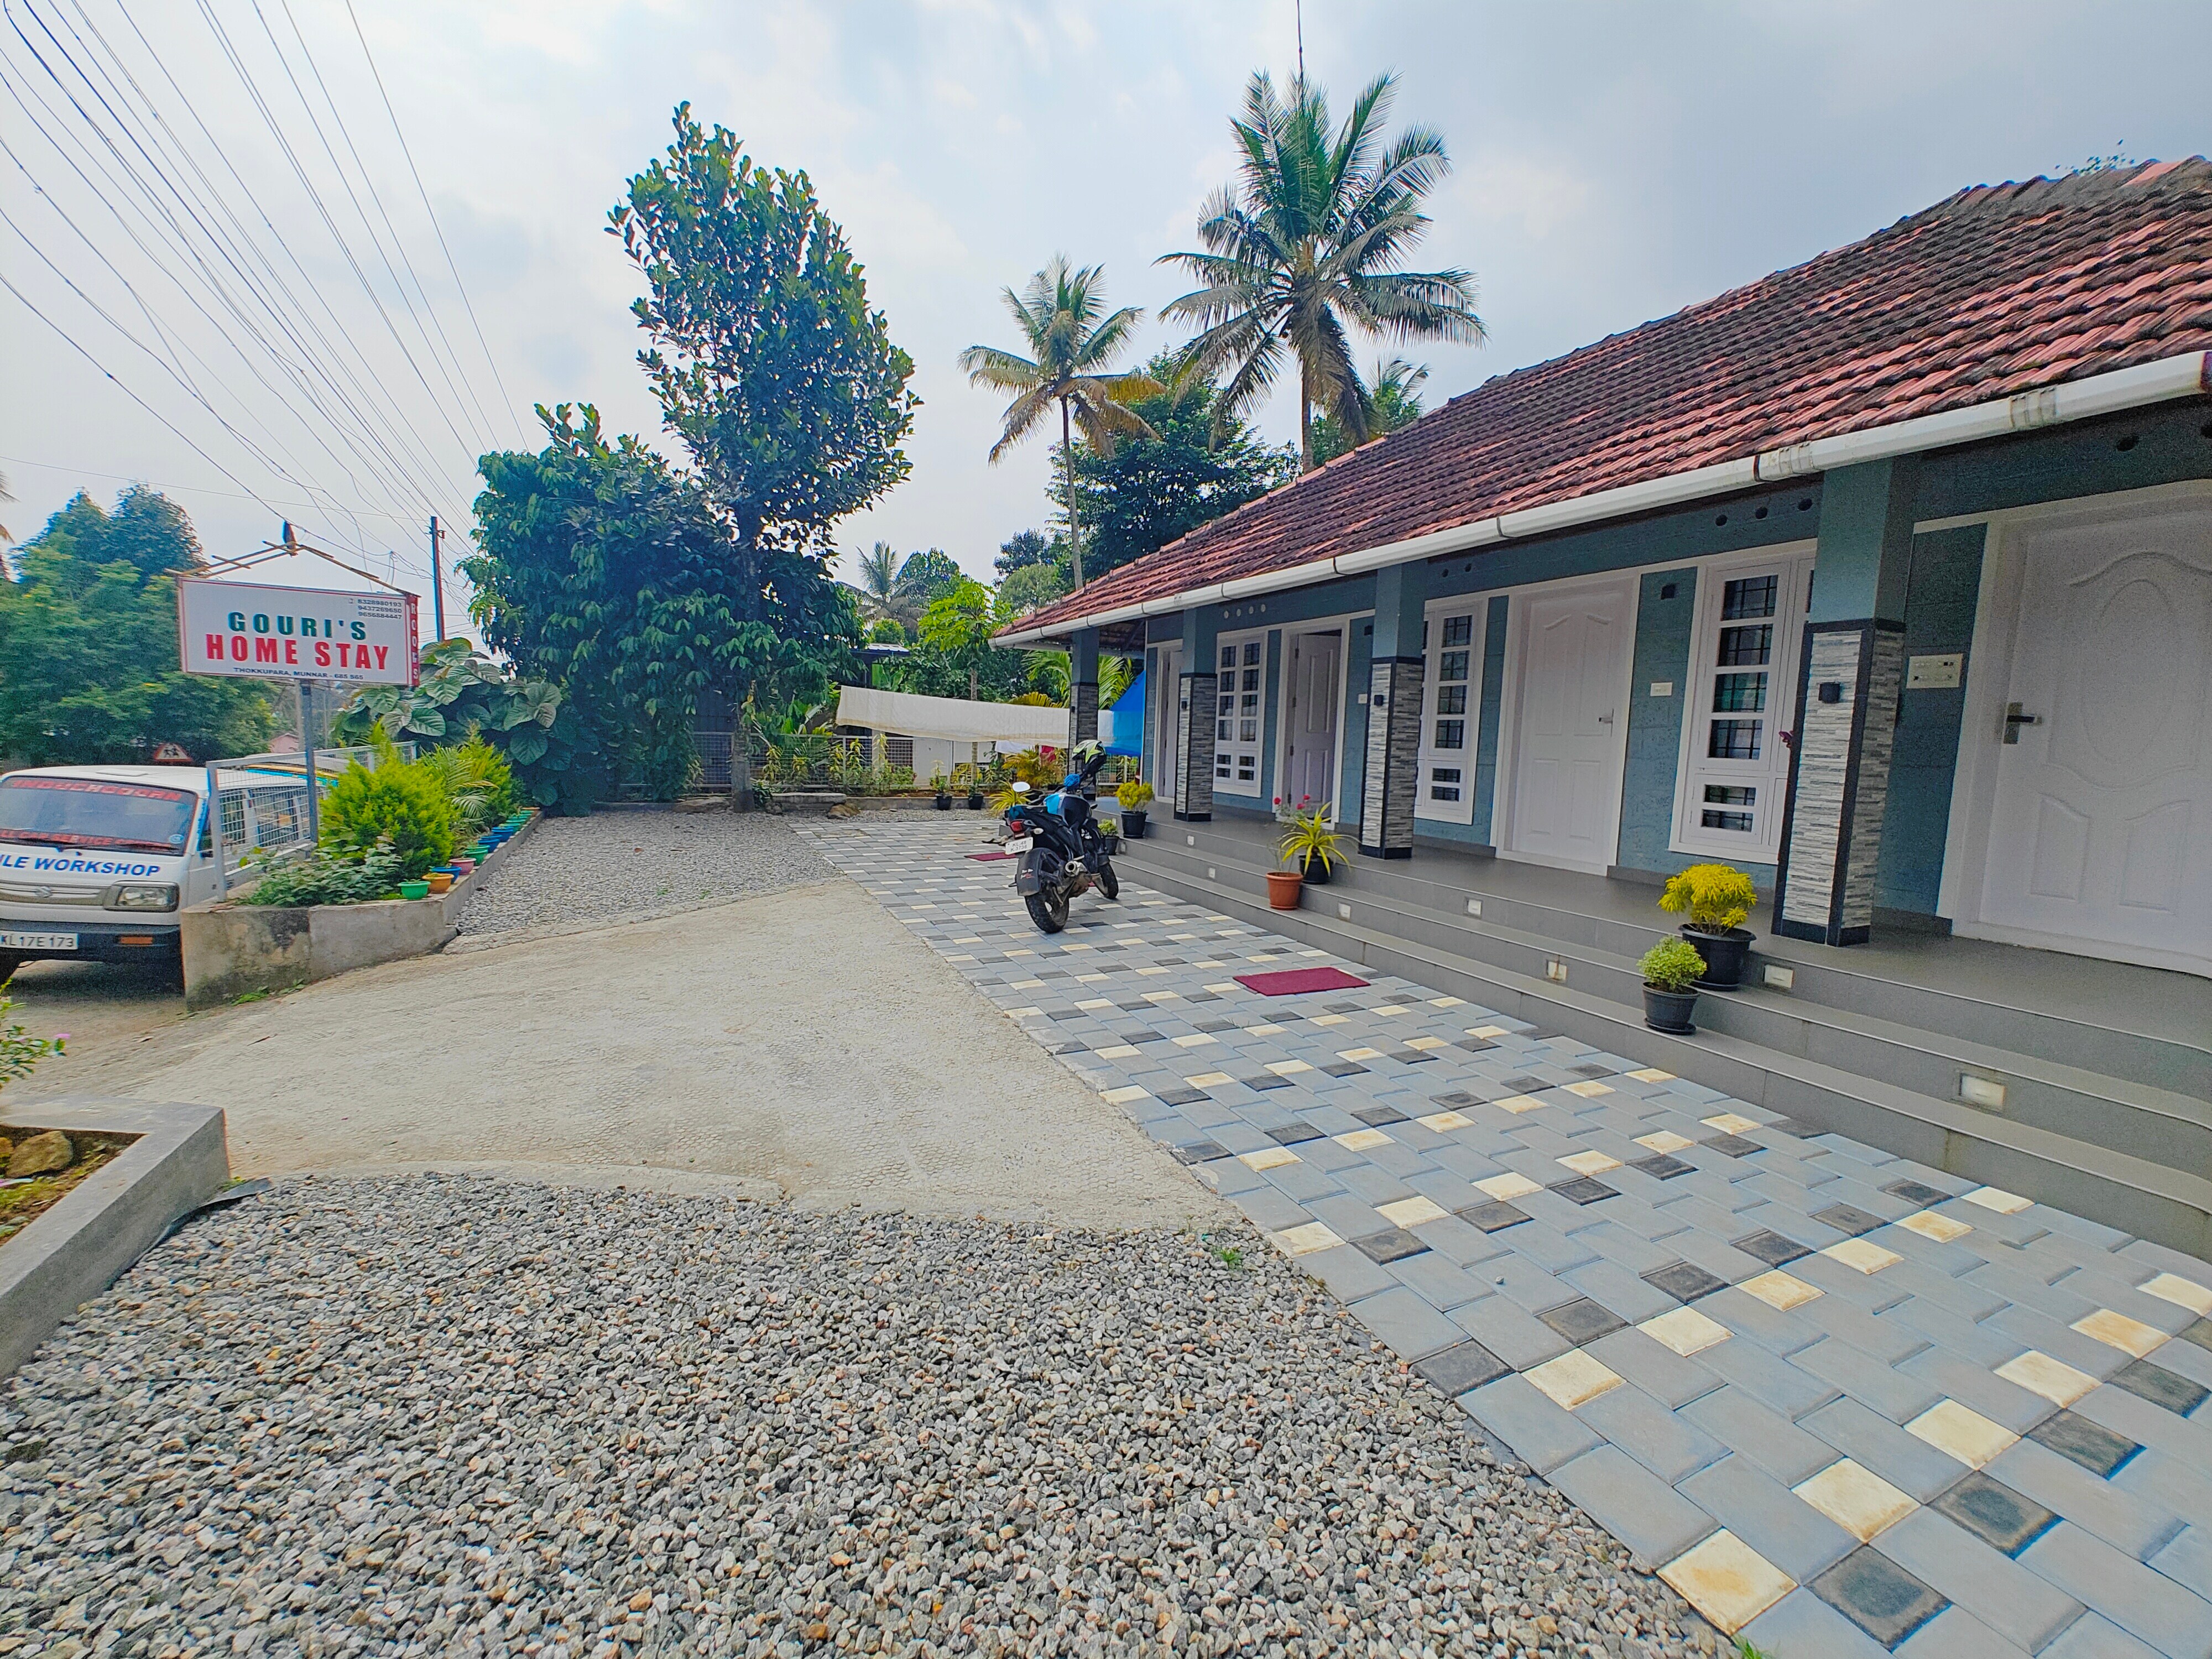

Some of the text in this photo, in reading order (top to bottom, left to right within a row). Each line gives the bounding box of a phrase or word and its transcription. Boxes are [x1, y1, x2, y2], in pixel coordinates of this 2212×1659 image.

[228, 612, 367, 640] GOURI'S
[206, 634, 389, 670] HOME STAY
[233, 667, 291, 676] THOKKUPARA,
[34, 858, 160, 877] WORKSHOP
